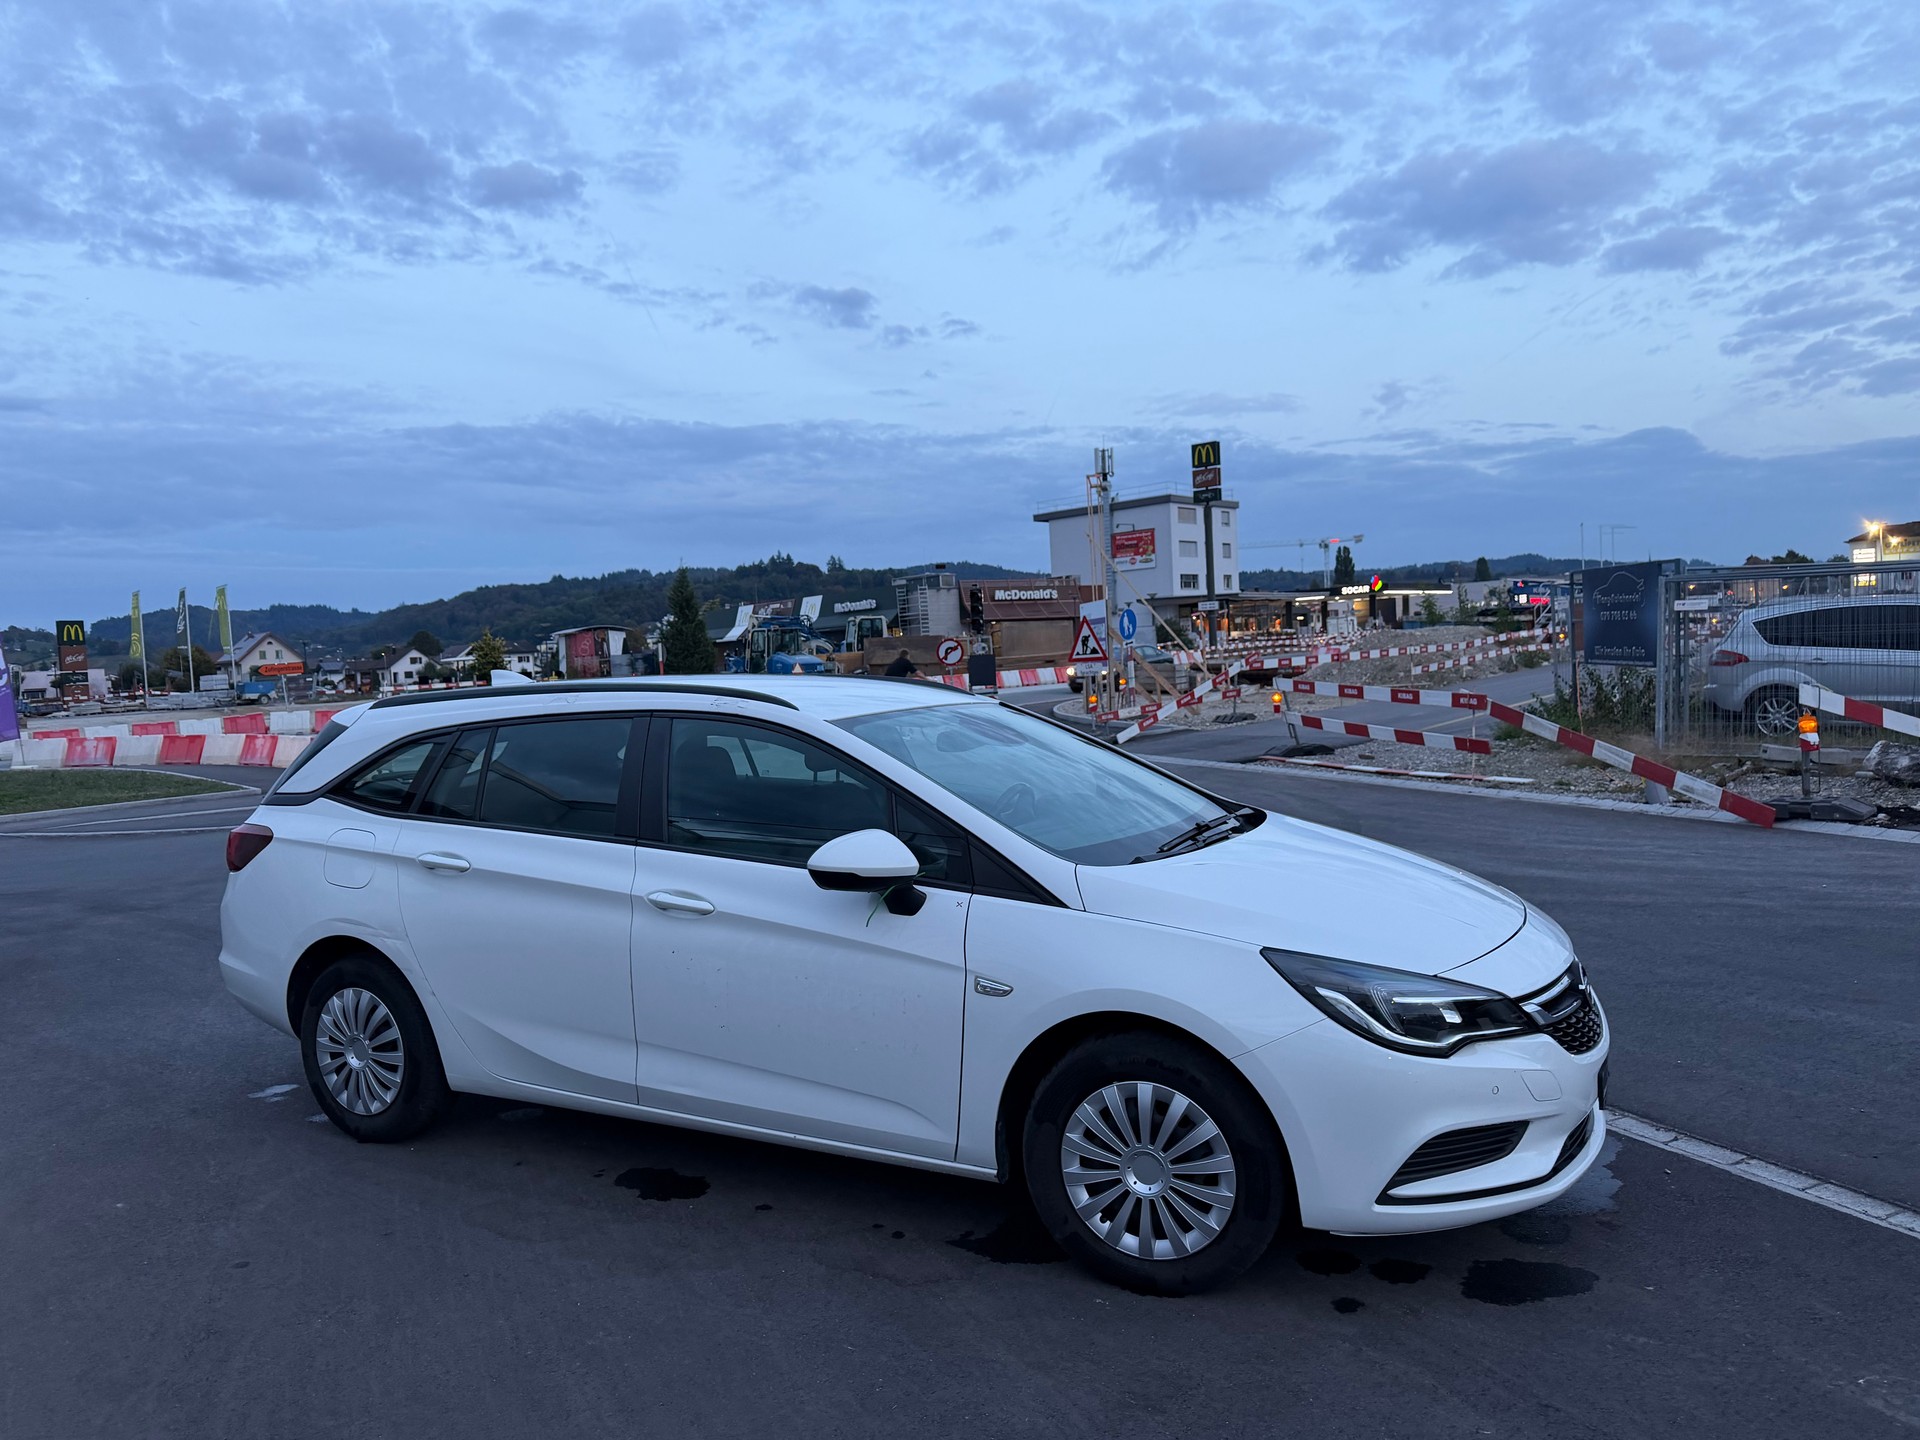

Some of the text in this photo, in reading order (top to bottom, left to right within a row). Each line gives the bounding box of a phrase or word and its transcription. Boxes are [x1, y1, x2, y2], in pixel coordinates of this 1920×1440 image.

[994, 588, 1058, 601] McDonald's
[1341, 585, 1370, 595] SOCAR
[834, 599, 877, 613] McDonald's
[1398, 692, 1413, 700] KIBAG
